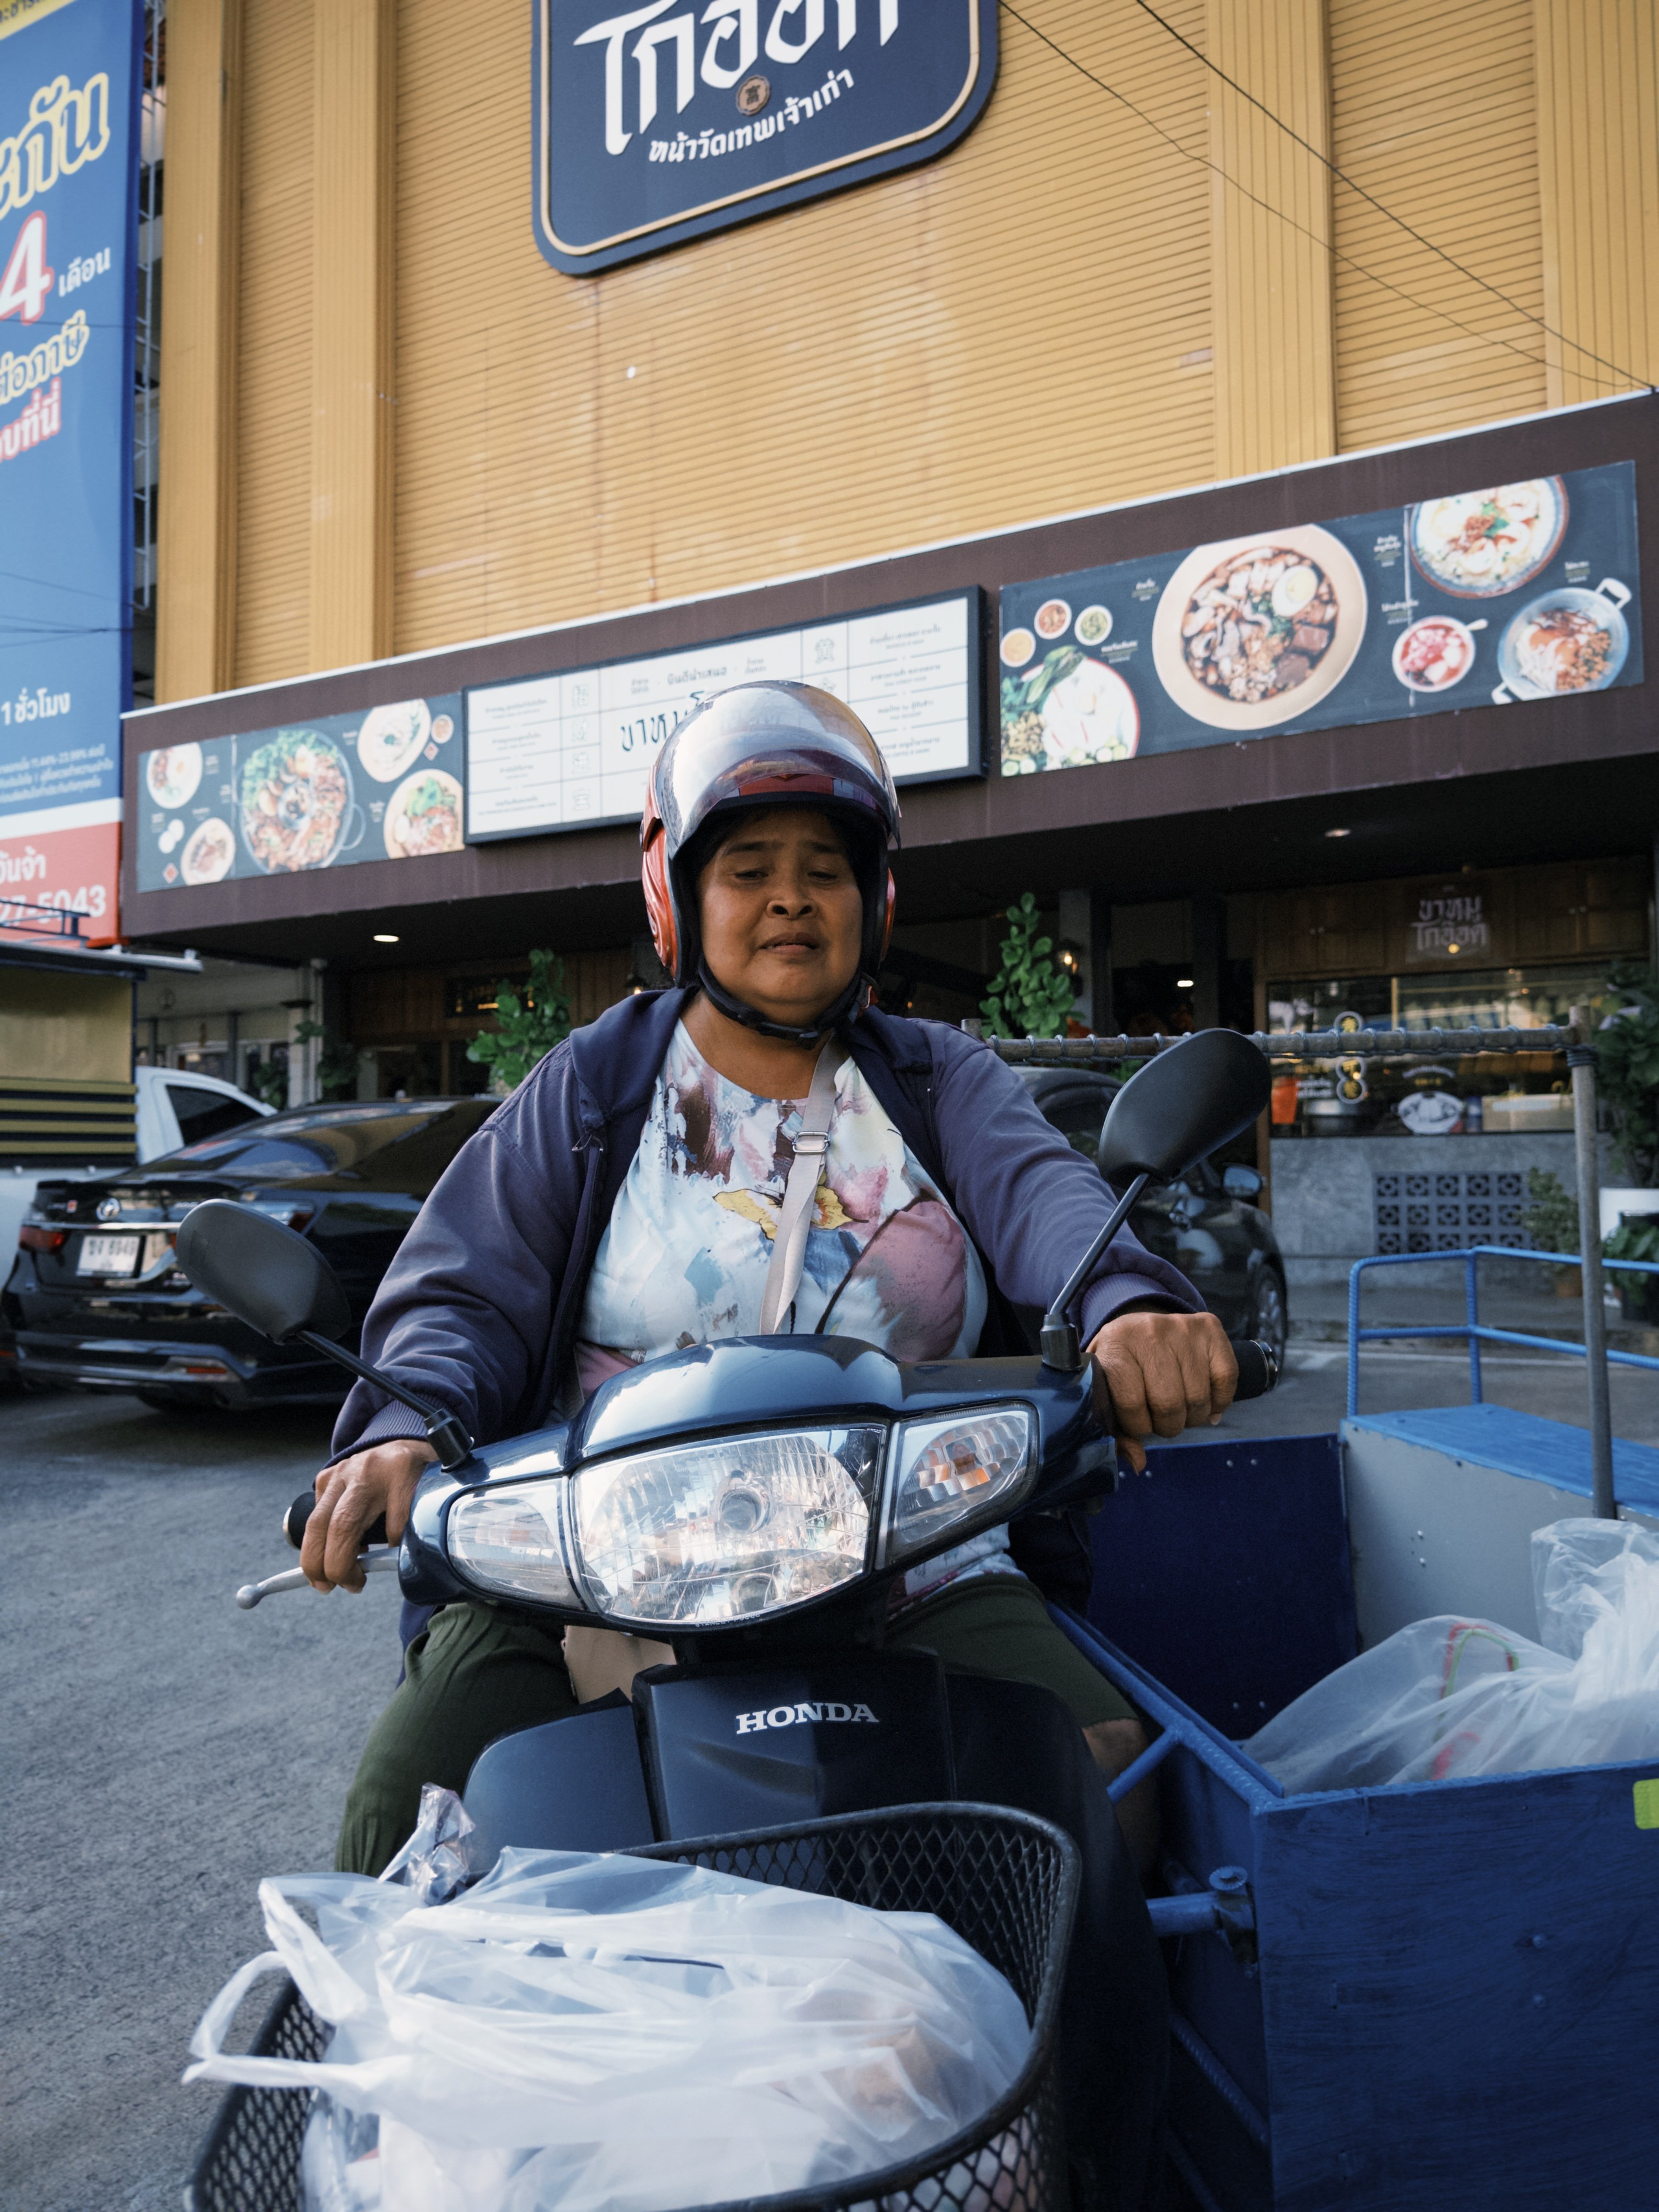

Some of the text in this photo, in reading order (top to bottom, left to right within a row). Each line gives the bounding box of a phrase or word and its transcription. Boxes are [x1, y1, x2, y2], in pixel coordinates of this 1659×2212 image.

[649, 69, 855, 163] หน้าวัดเทพเจ้าเก่า
[59, 248, 111, 297] เดือน
[0, 377, 62, 465] บที่นี่
[1, 687, 71, 726] 1 ชั่วโมง
[736, 1703, 879, 1735] HONDA
